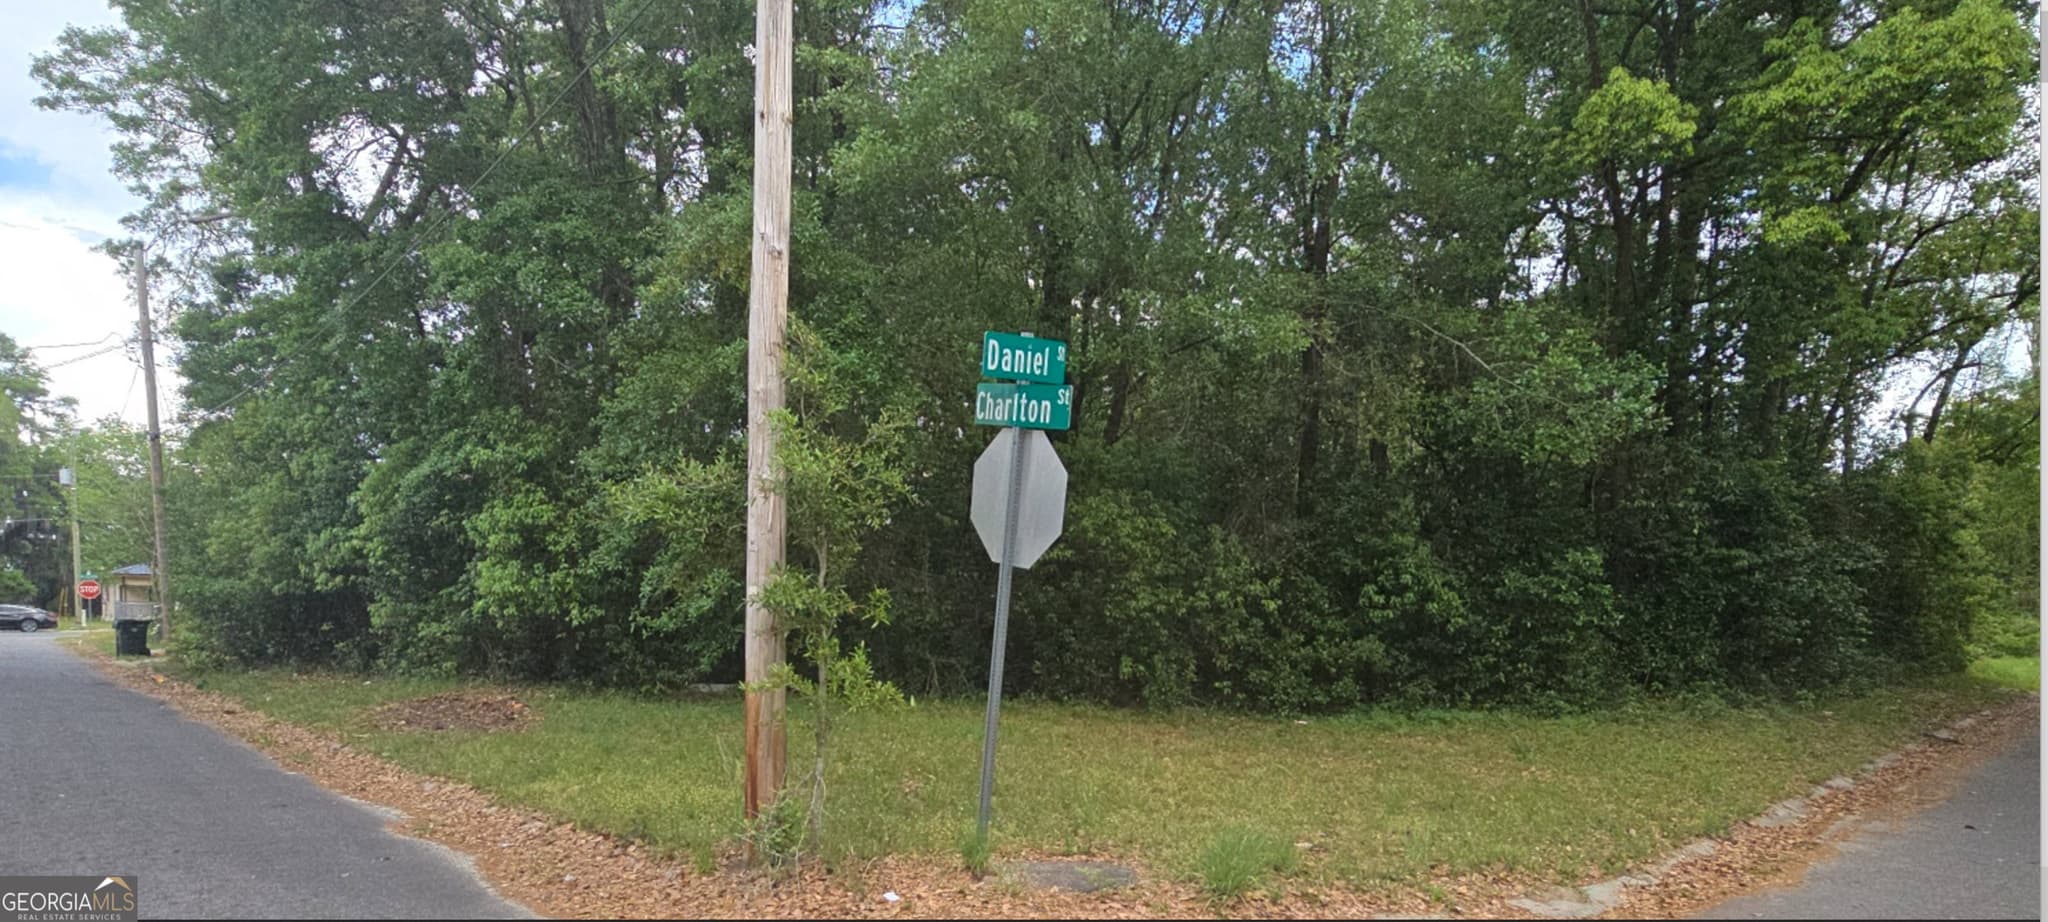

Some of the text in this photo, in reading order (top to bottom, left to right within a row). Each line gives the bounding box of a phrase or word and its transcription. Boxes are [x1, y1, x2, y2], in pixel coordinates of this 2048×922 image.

[987, 339, 1049, 376] Daniel
[976, 388, 1069, 424] Charlton St
[79, 585, 99, 593] STOP
